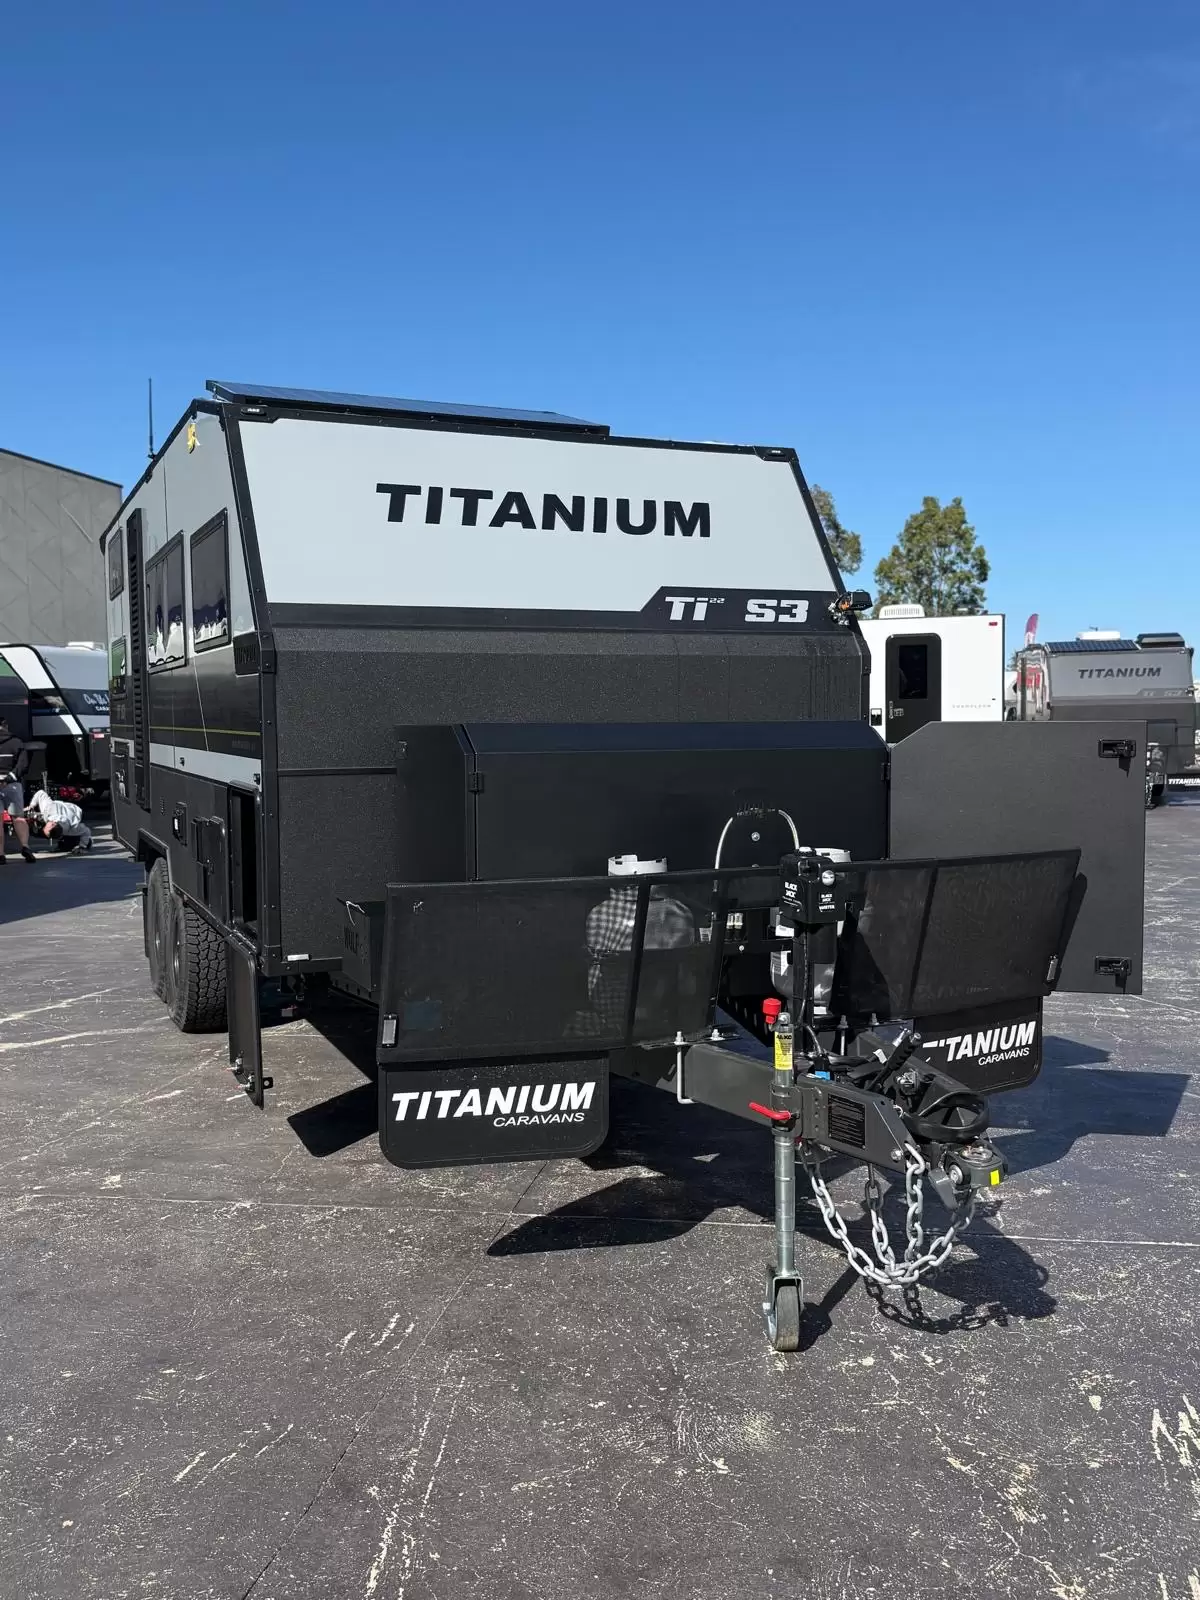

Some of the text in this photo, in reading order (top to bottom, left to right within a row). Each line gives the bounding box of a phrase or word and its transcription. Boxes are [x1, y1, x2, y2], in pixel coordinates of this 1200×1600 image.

[376, 483, 710, 538] TITANIUM
[744, 599, 809, 623] S3
[1078, 667, 1162, 679] TITANIUM
[978, 1047, 1030, 1066] CARAVANS
[391, 1081, 596, 1121] TITANIUM
[493, 1112, 585, 1127] CARAVANS
